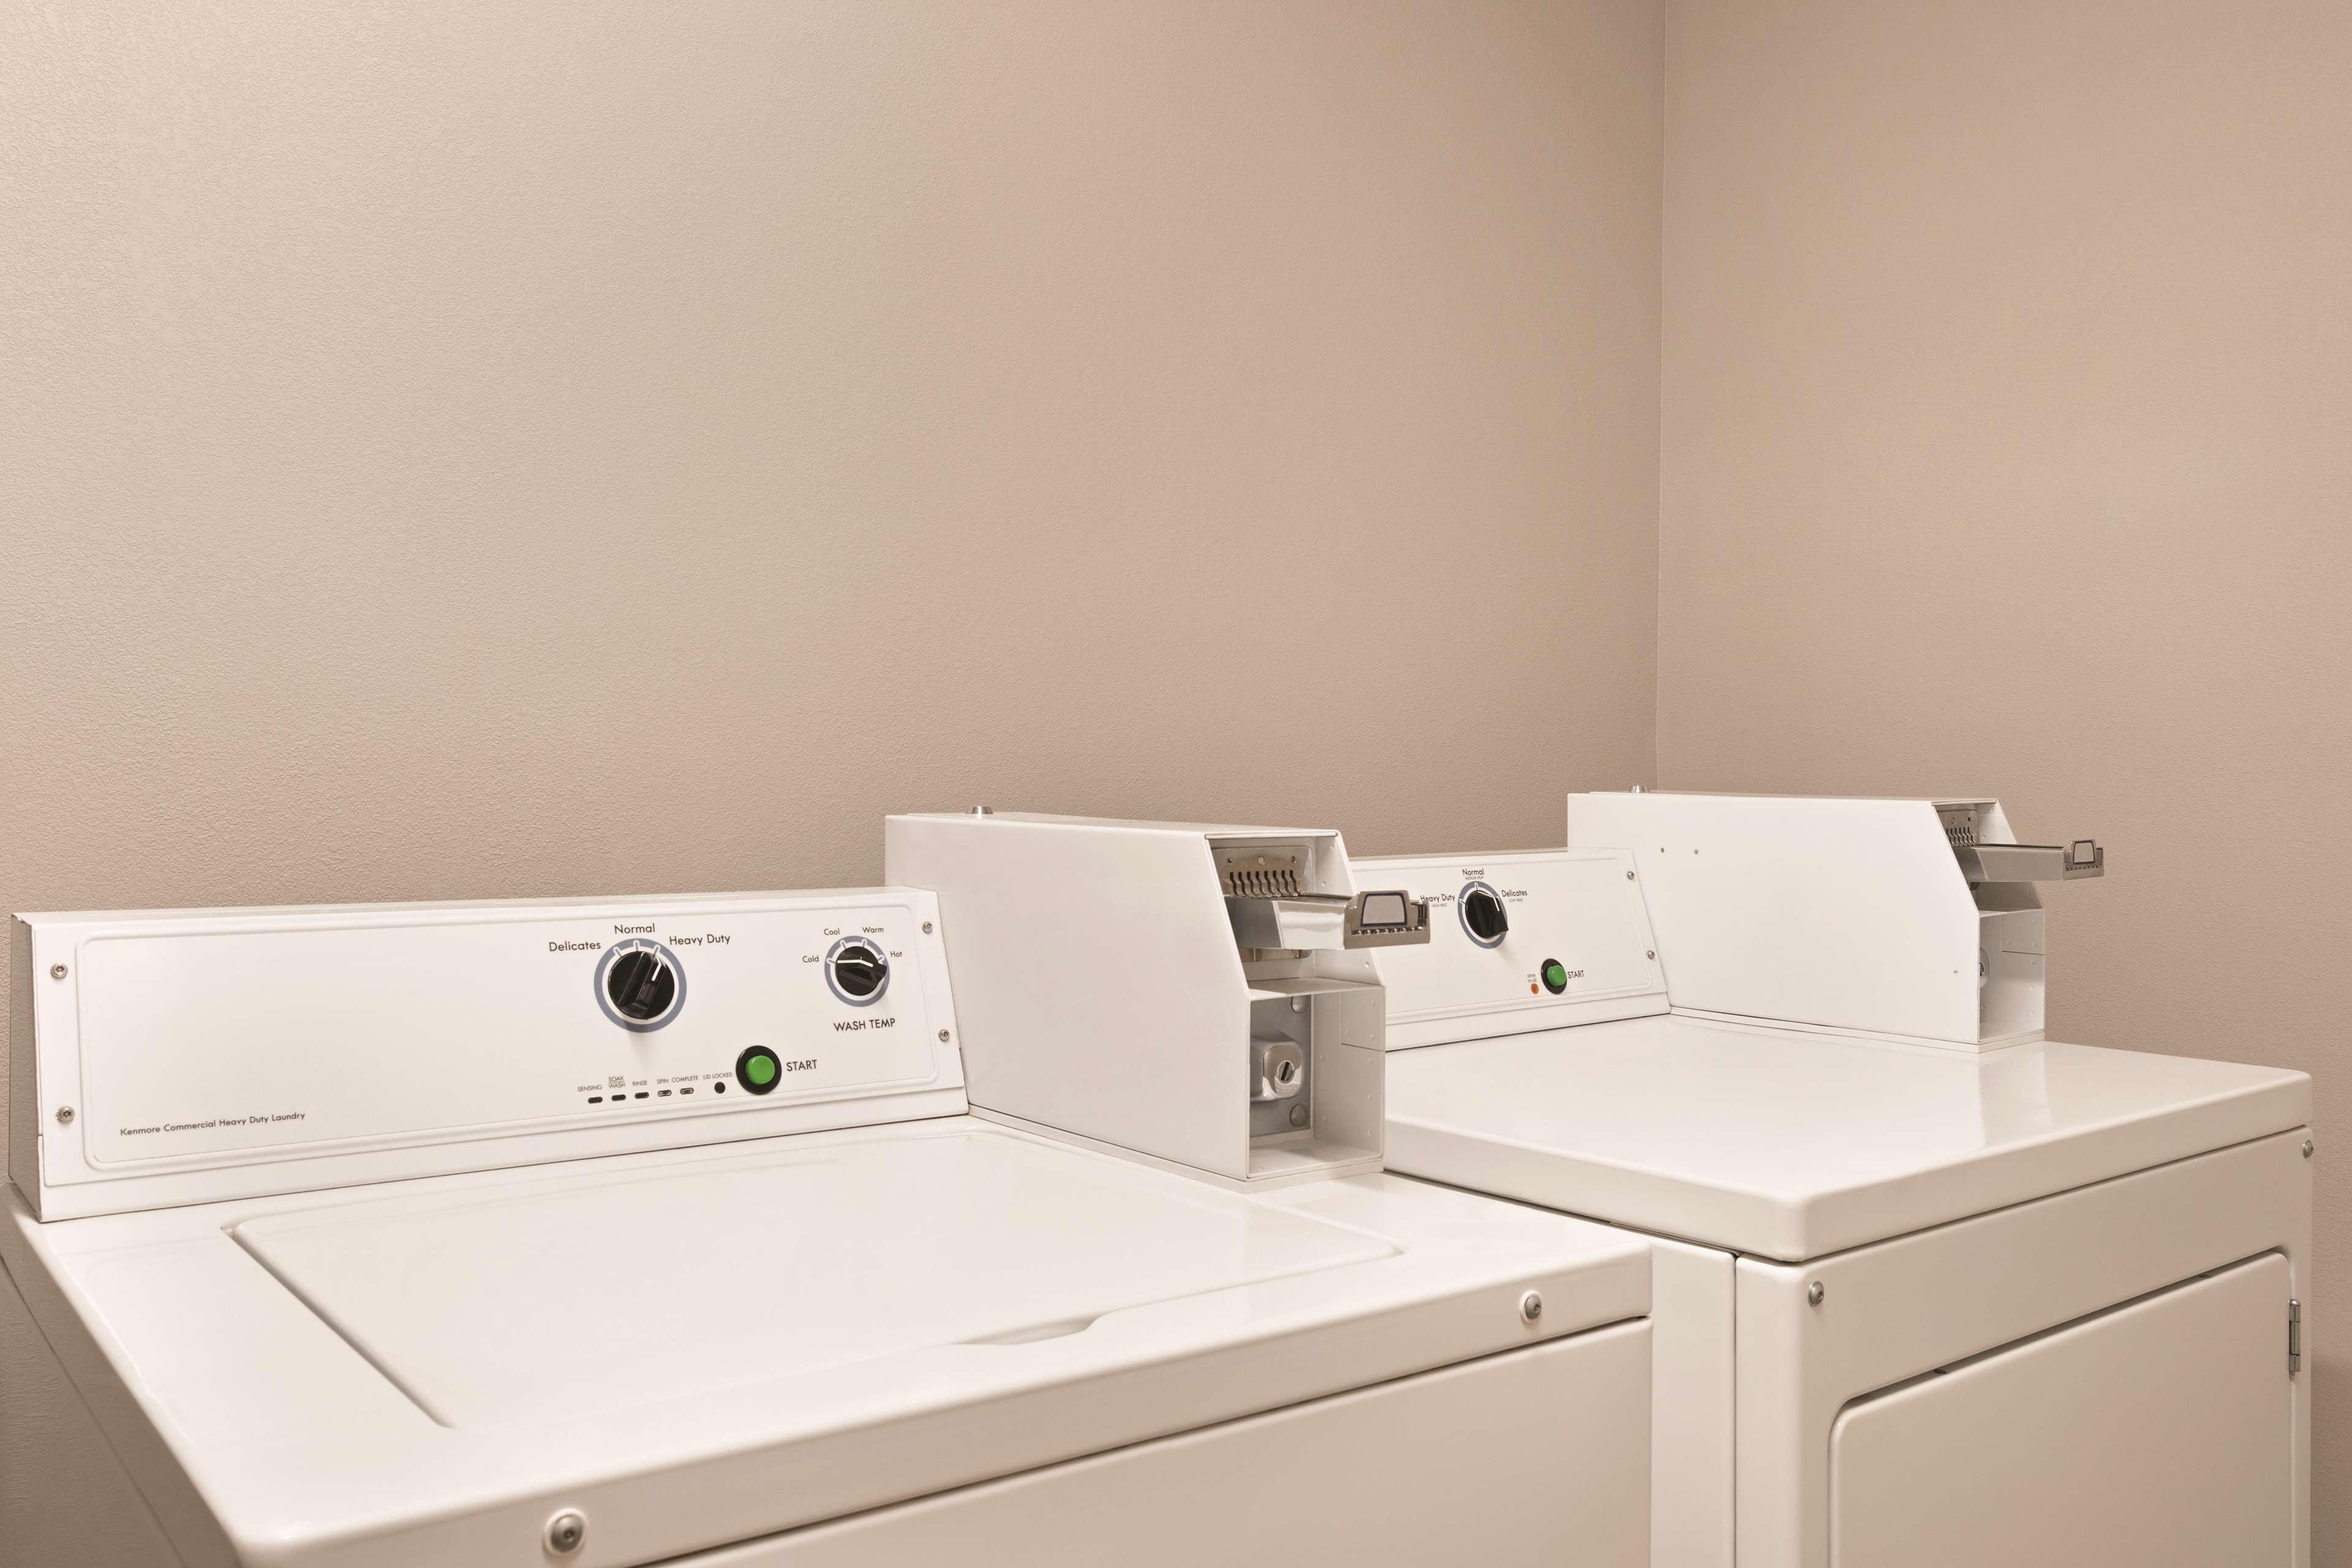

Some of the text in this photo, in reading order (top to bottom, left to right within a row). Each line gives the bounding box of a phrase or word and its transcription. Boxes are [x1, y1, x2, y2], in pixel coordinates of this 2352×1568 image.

[1501, 889, 1528, 898] Delicates
[614, 923, 655, 935] Normal
[669, 933, 731, 946] Heavy Duty
[549, 941, 601, 952] Delicates
[1567, 970, 1585, 979] START
[833, 1018, 895, 1031] WASH TEMP
[786, 1060, 818, 1072] START
[120, 1112, 306, 1136] Kenmore Commercial Heavy Duty Laundry
